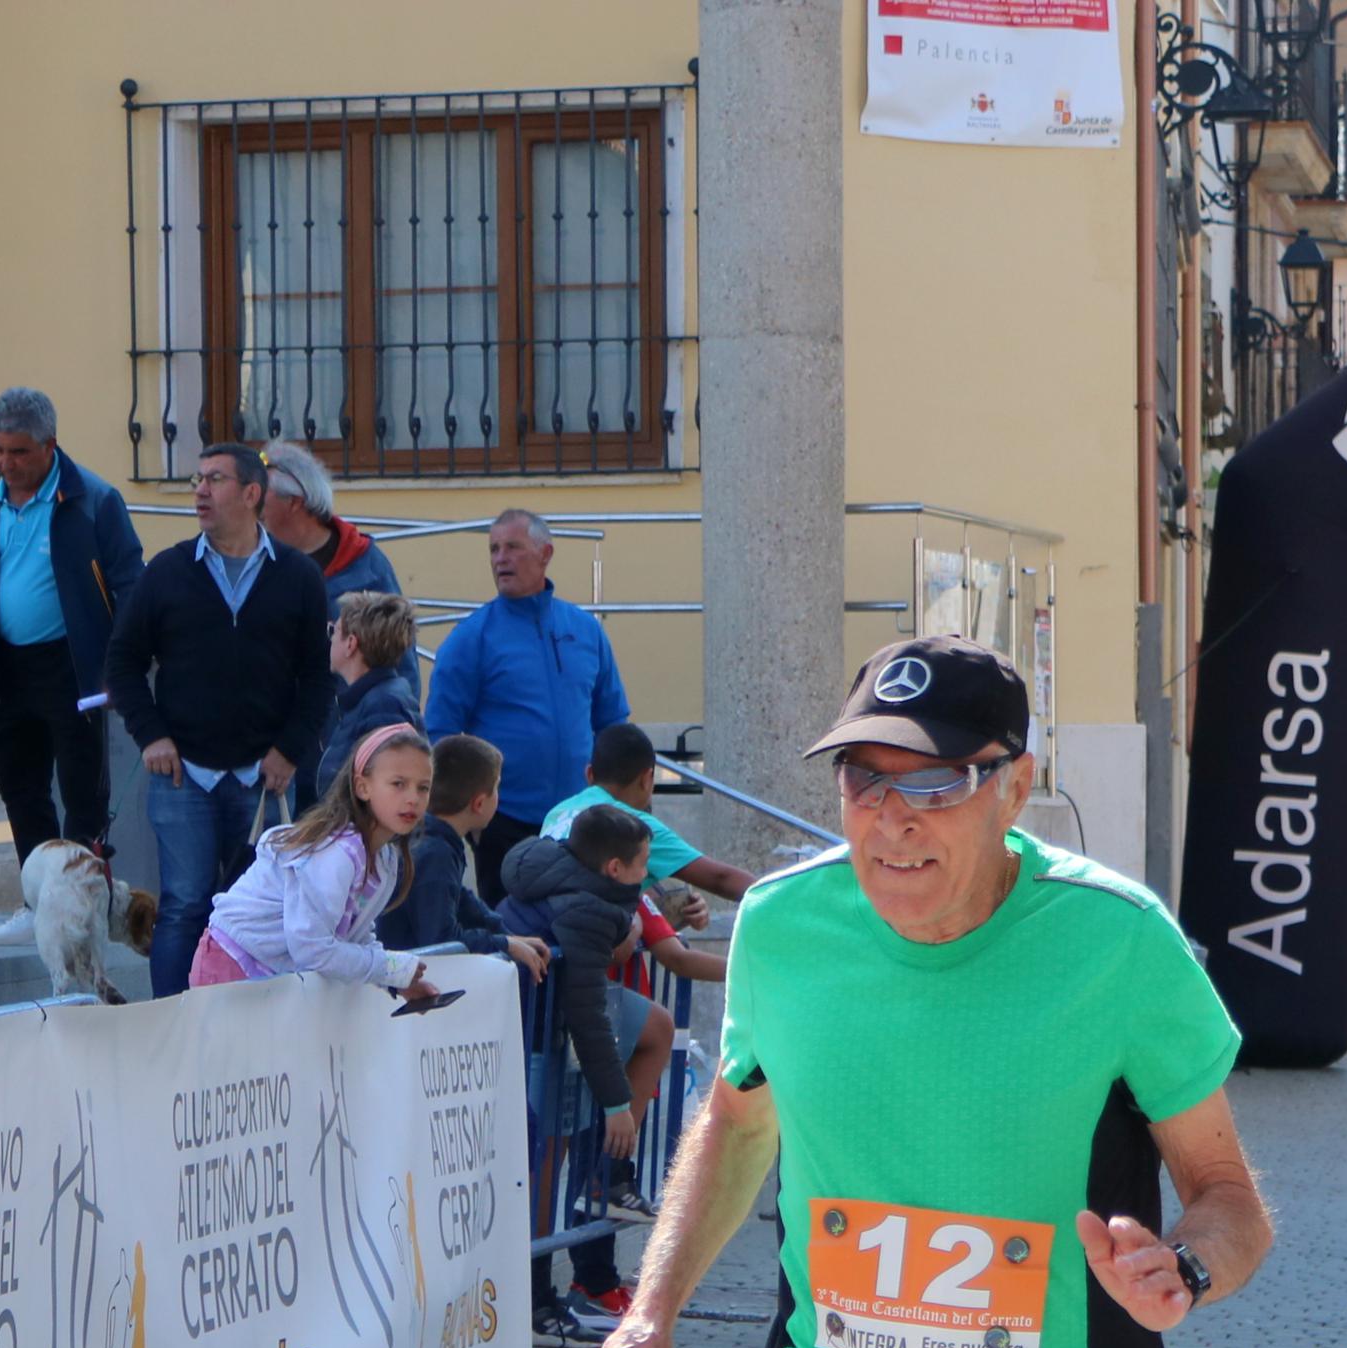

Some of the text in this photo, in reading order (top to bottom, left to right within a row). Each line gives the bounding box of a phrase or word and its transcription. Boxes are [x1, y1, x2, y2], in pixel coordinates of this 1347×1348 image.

[917, 38, 1013, 65] Palencia
[1227, 648, 1331, 977] Adarsa
[173, 1072, 292, 1151] CLUB DEPORTIVO
[420, 1047, 449, 1099] CLUB
[177, 1141, 294, 1244] ATLETISMO DEL
[180, 1226, 299, 1340] CERRATO
[858, 1214, 995, 1309] 12
[872, 1300, 948, 1323] Castellana
[952, 1311, 972, 1326] del
[978, 1312, 1033, 1328] Cerrato
